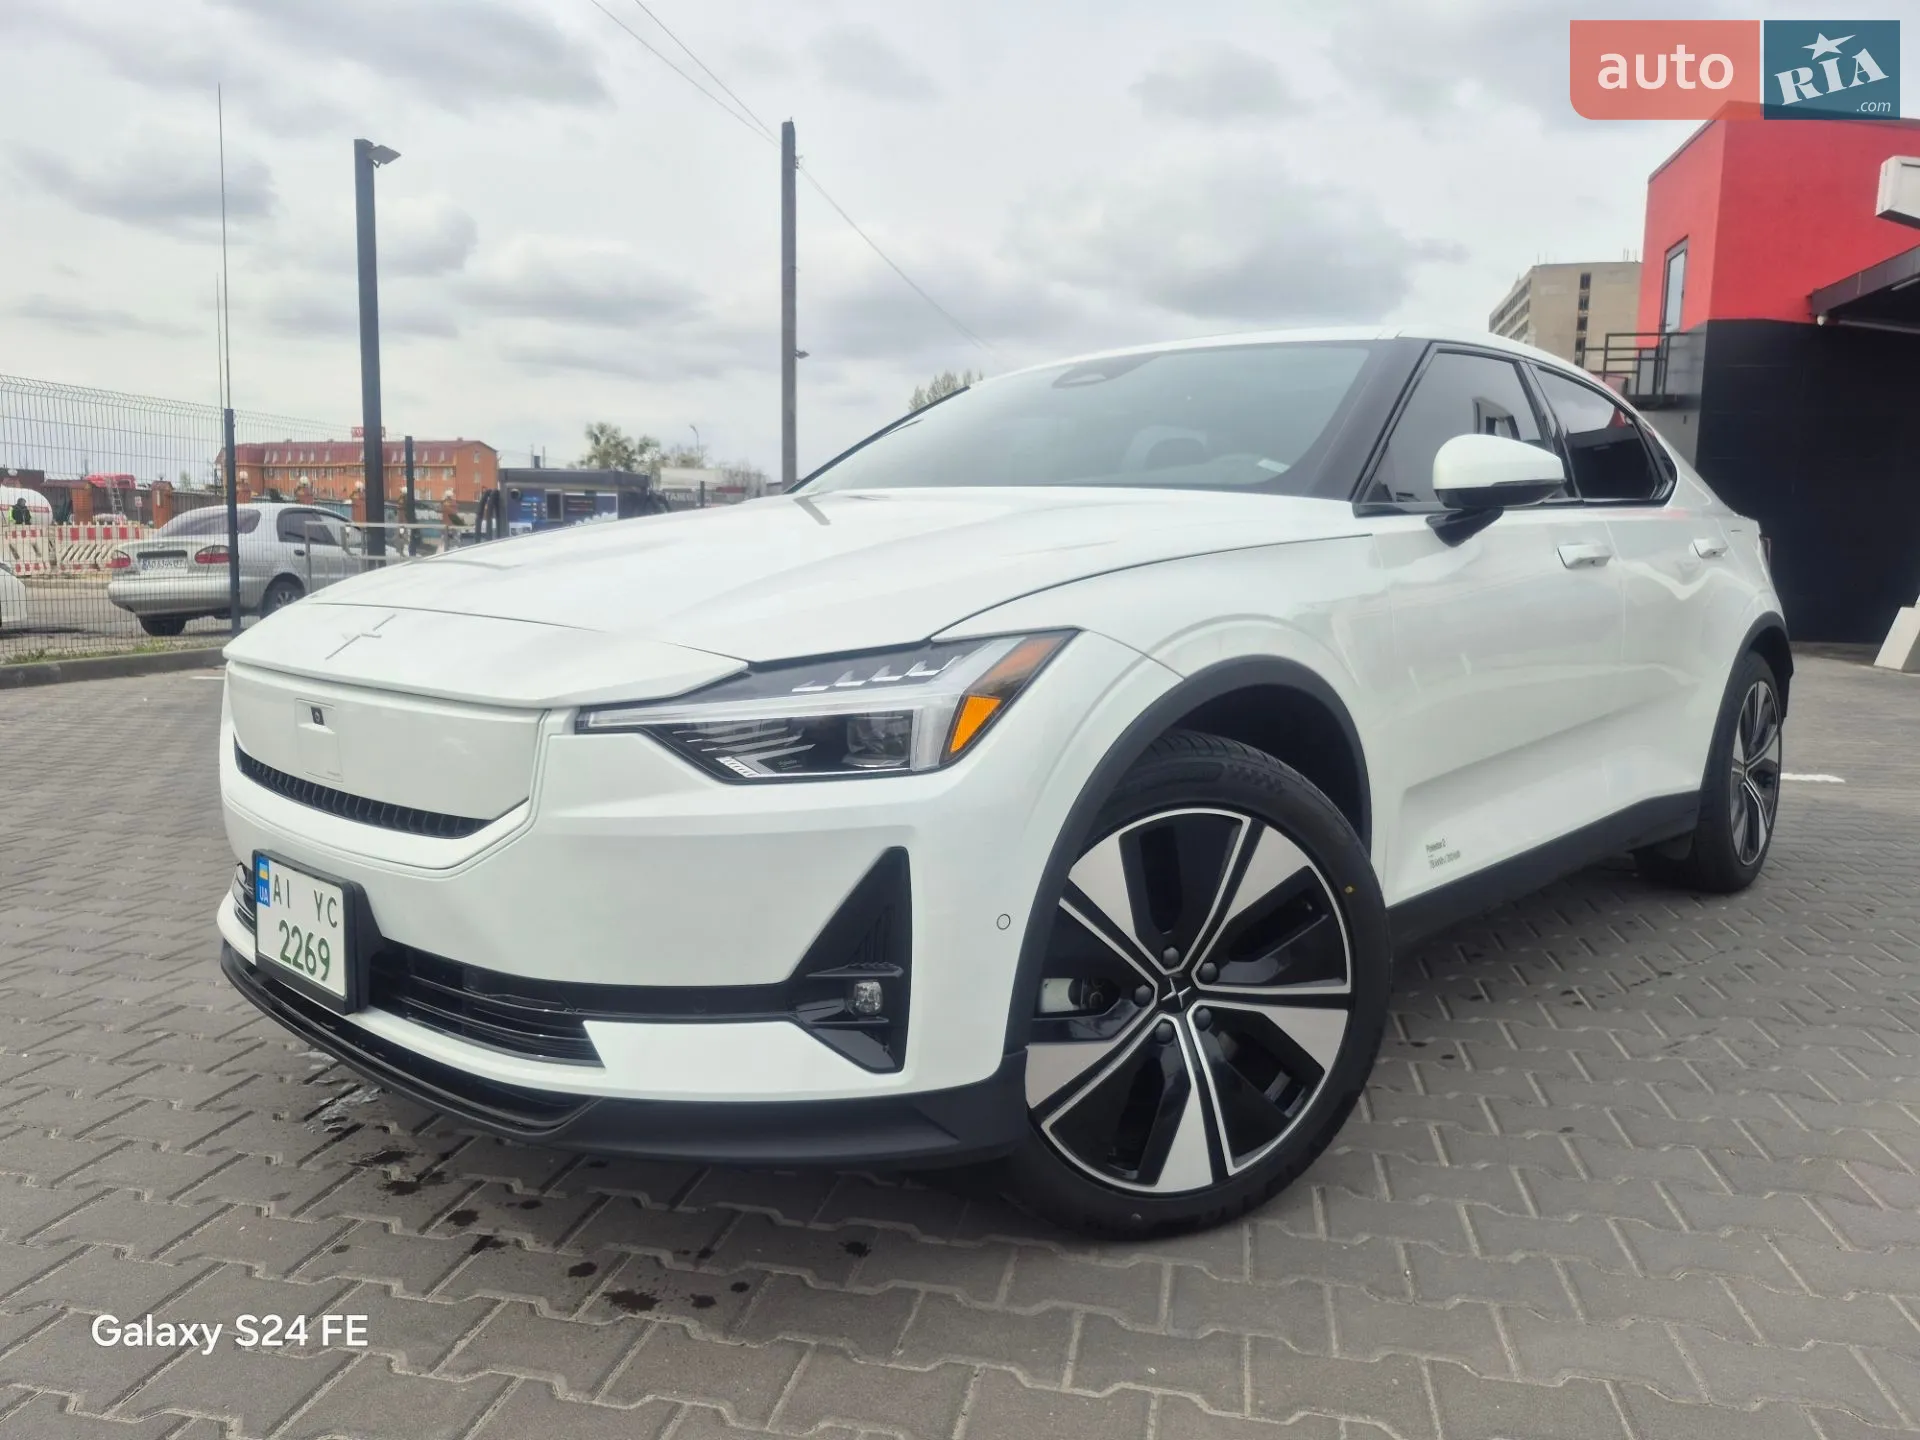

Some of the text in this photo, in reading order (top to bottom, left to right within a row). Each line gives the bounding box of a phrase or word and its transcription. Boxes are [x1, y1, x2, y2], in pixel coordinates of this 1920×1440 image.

[258, 885, 269, 903] UA
[273, 874, 338, 929] AI YC
[278, 919, 331, 982] 2269
